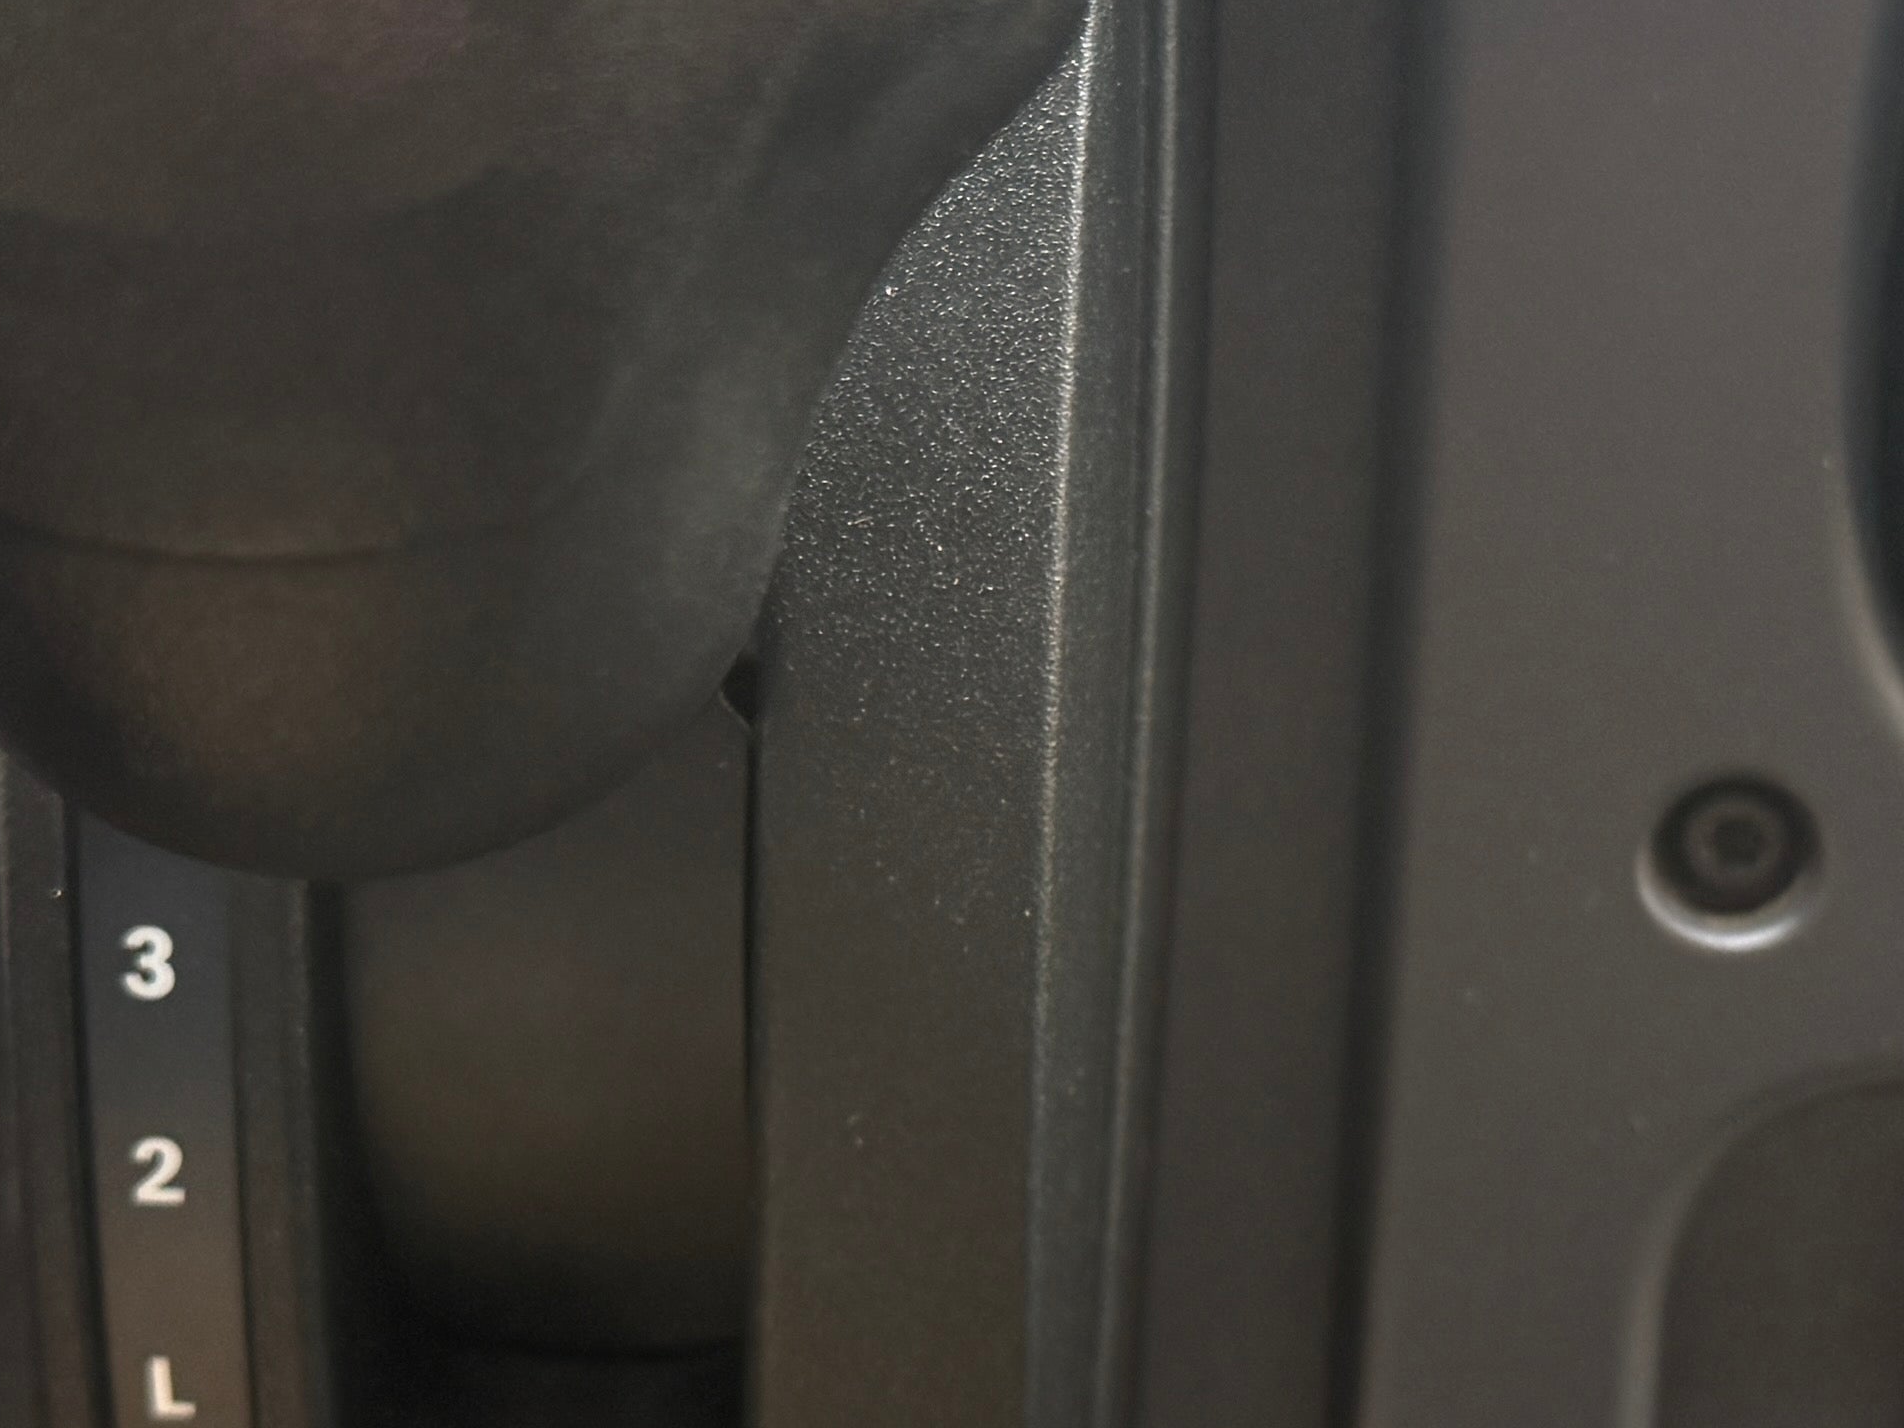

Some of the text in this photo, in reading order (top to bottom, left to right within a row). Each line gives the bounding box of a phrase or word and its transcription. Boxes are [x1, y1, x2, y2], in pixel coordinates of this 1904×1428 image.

[122, 925, 176, 1001] 3
[132, 1136, 186, 1207] 2
[148, 1355, 197, 1421] L
